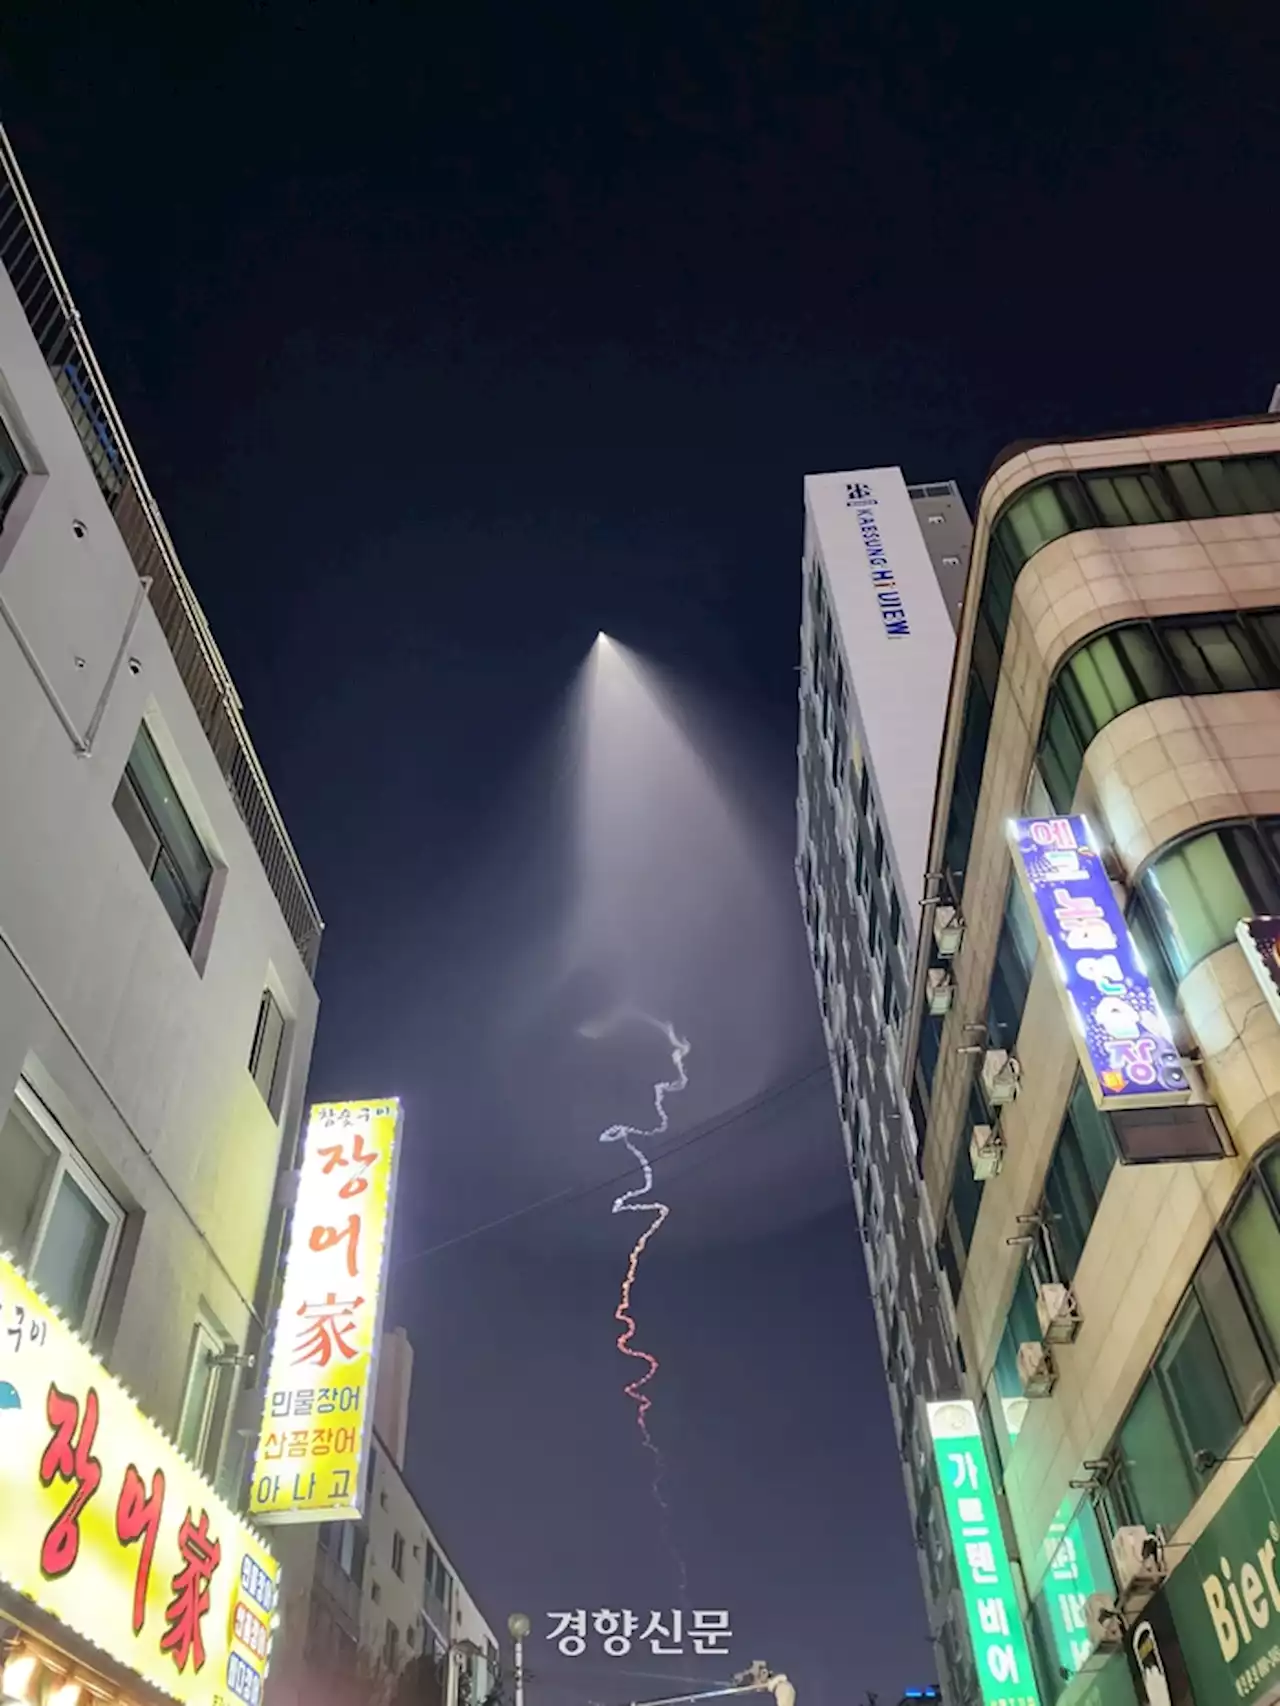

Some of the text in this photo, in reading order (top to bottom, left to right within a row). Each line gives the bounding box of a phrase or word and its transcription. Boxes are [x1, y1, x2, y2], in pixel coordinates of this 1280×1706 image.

[857, 509, 887, 566] KAESUNG
[271, 1386, 361, 1418] 민물장어
[1202, 1538, 1280, 1663] Bier
